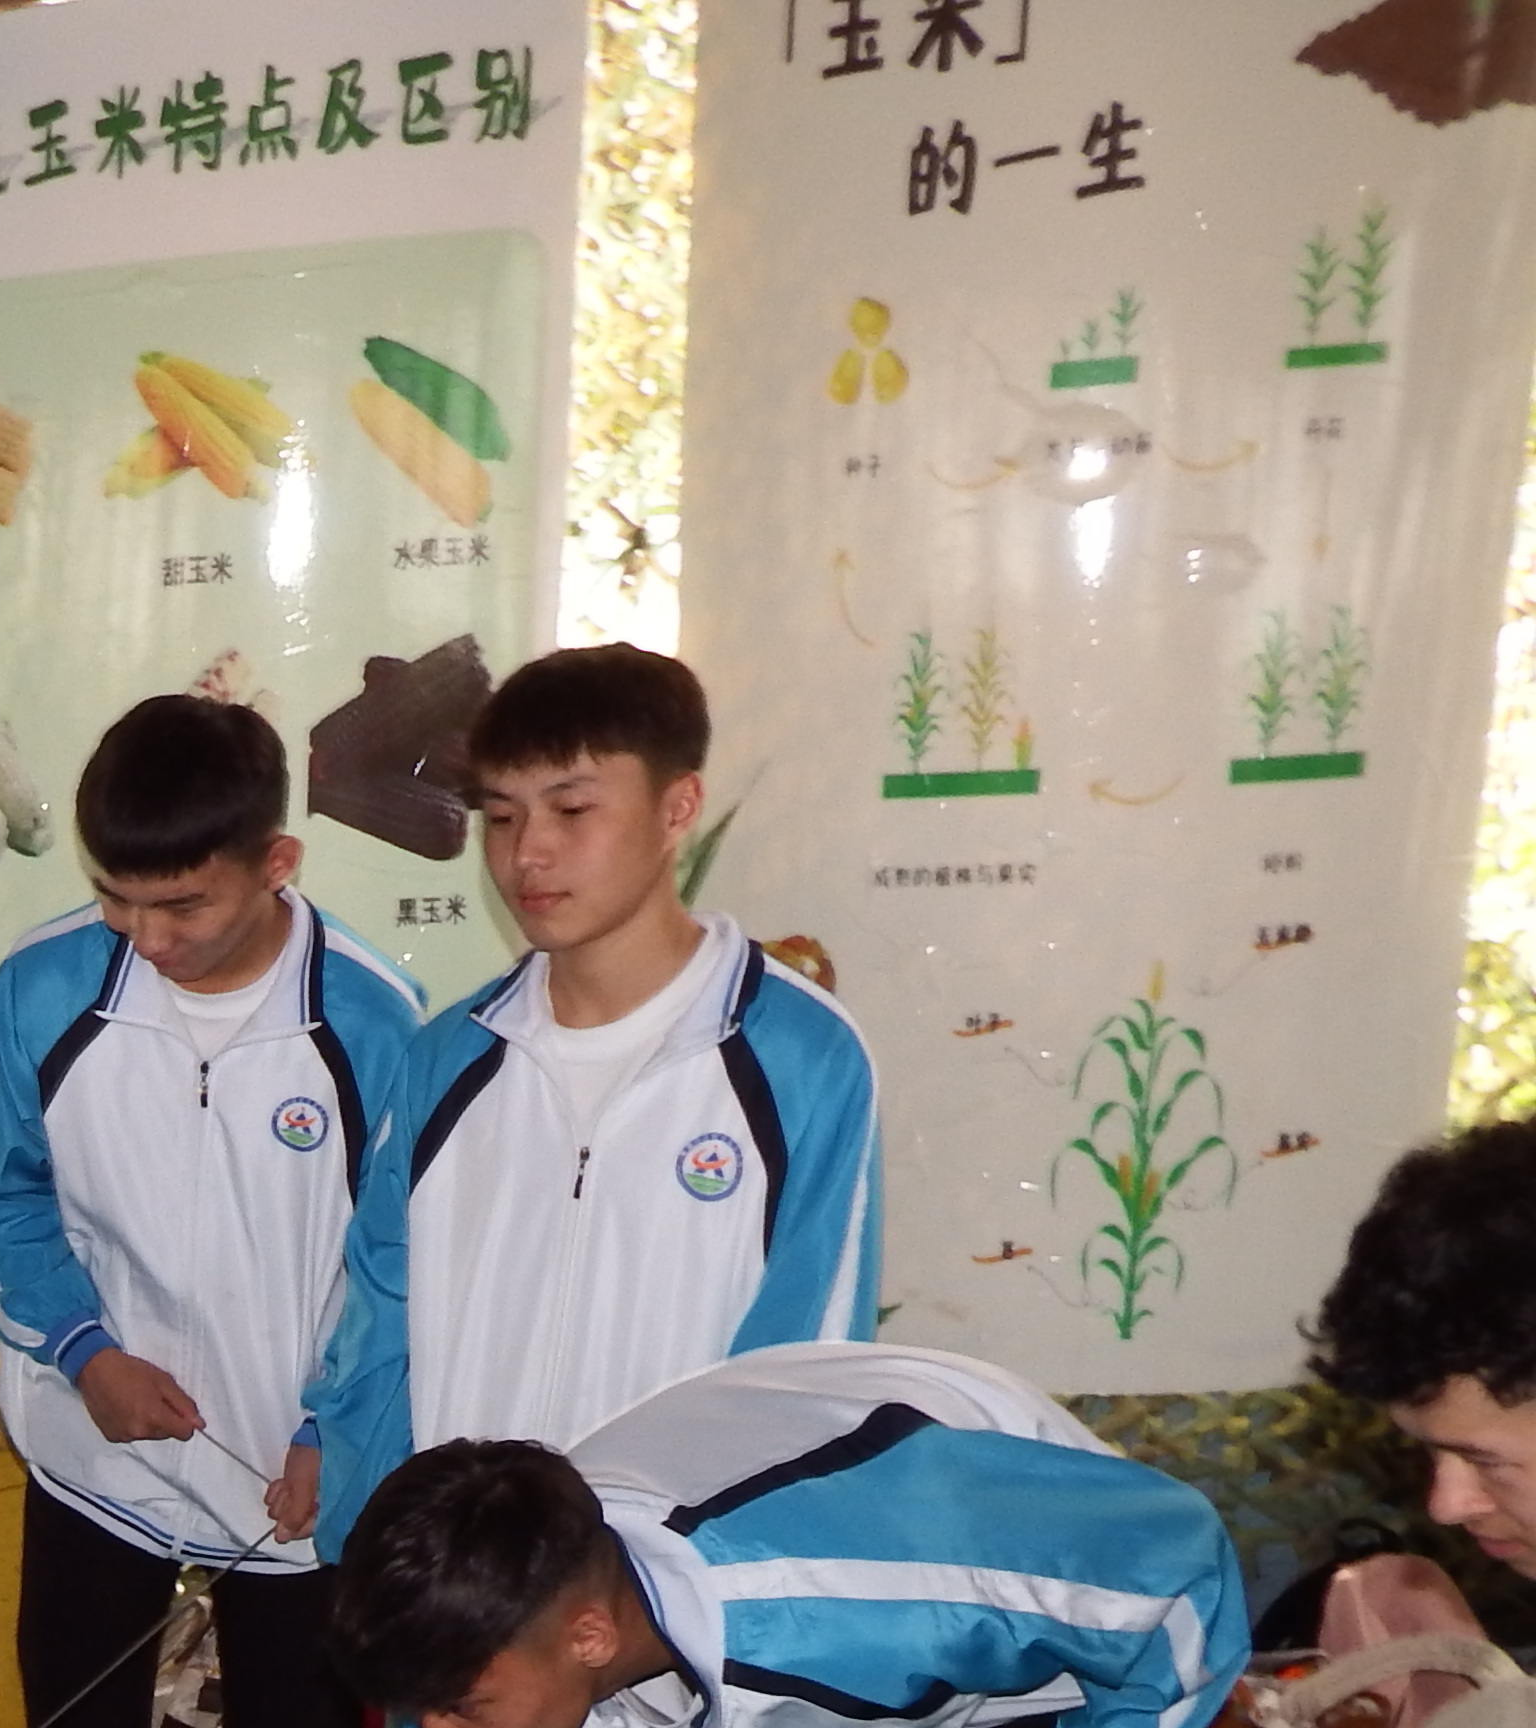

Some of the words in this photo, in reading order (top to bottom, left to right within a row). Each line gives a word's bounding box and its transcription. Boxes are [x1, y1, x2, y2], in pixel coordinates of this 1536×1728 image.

[908, 101, 1145, 216] 的一生
[162, 552, 233, 590] 甜玉米
[393, 534, 491, 571] 水果玉米
[396, 894, 467, 928] 黑玉米
